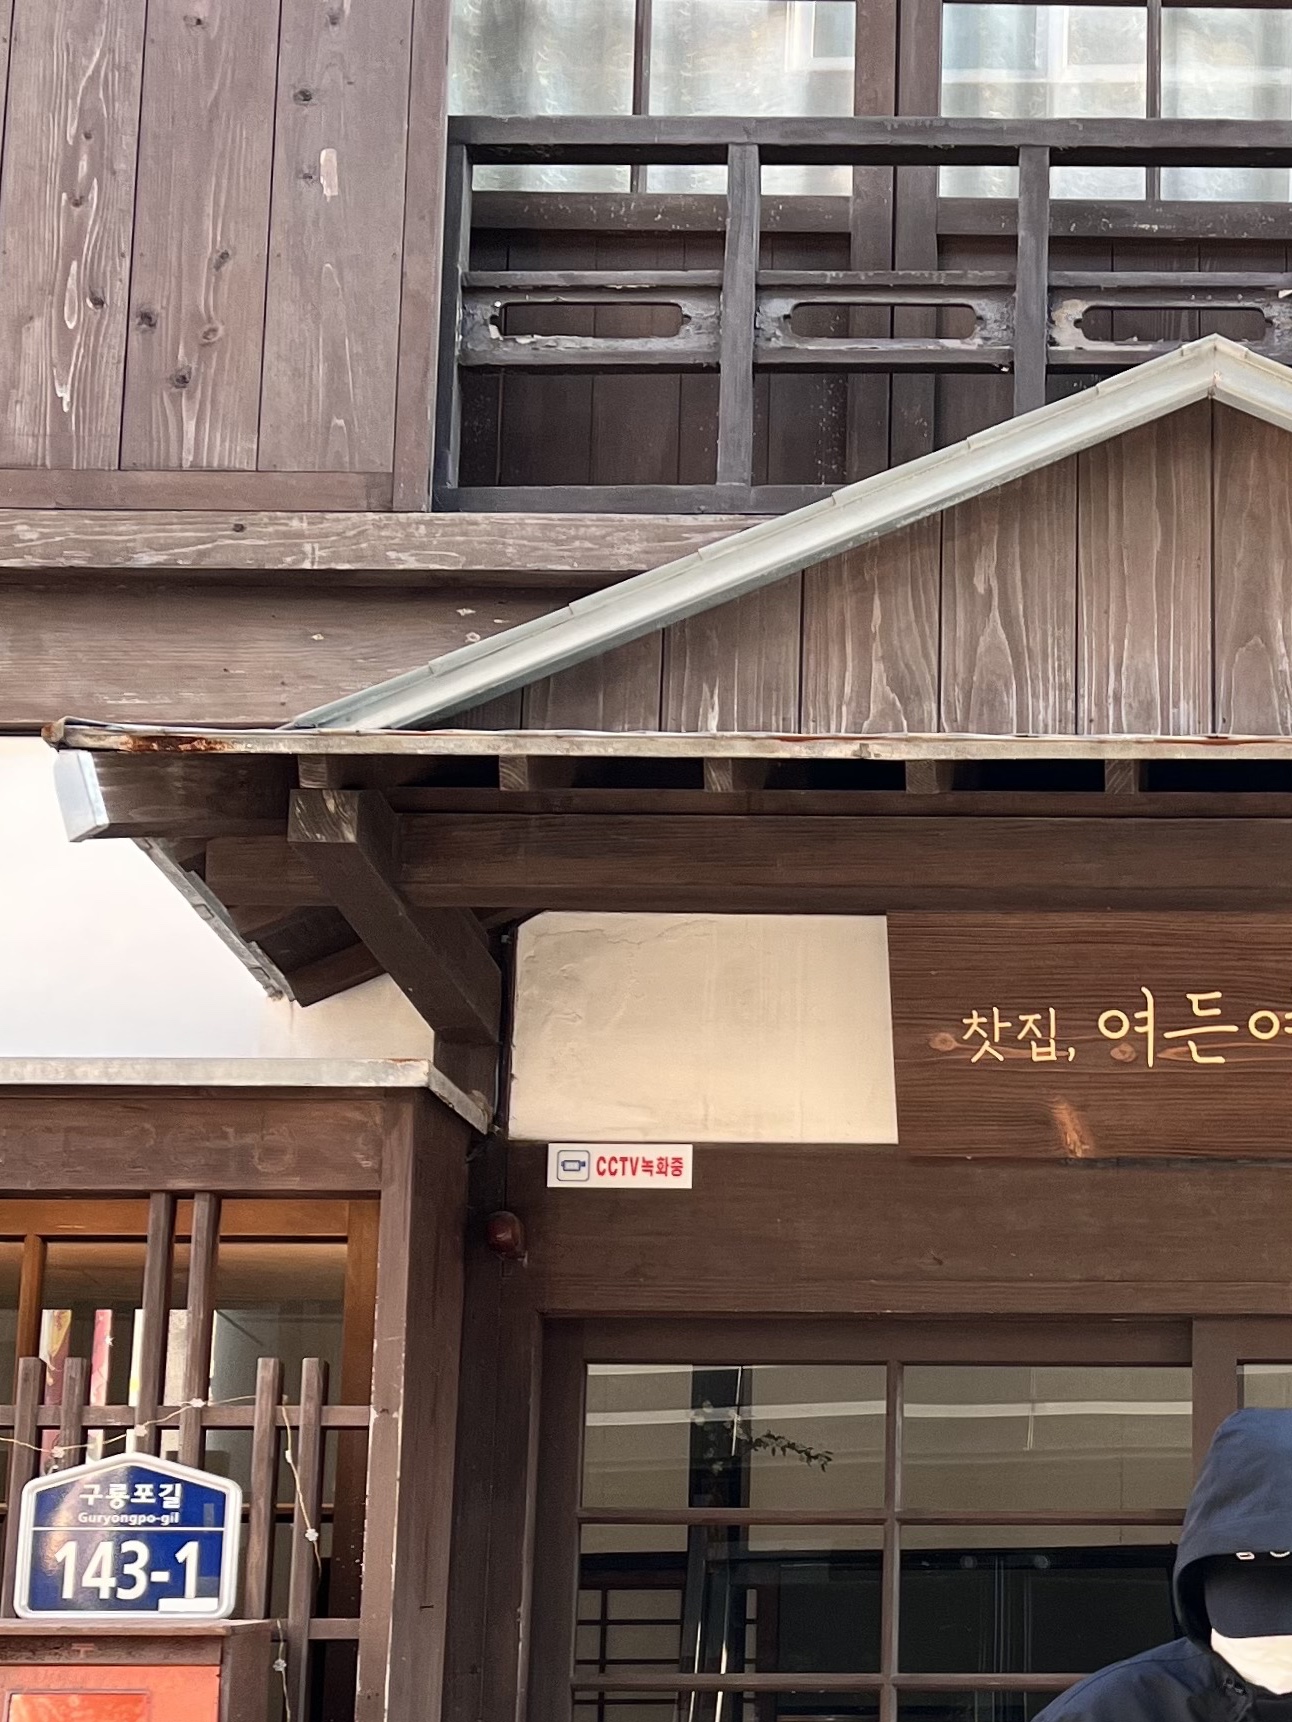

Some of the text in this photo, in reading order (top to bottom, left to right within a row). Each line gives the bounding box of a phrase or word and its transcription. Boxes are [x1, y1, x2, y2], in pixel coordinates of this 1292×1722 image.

[962, 1006, 1076, 1063] 찻집,
[79, 1483, 182, 1510] 구룡포길
[78, 1512, 180, 1526] Guryongpo-gil
[54, 1540, 199, 1600] 143-1
